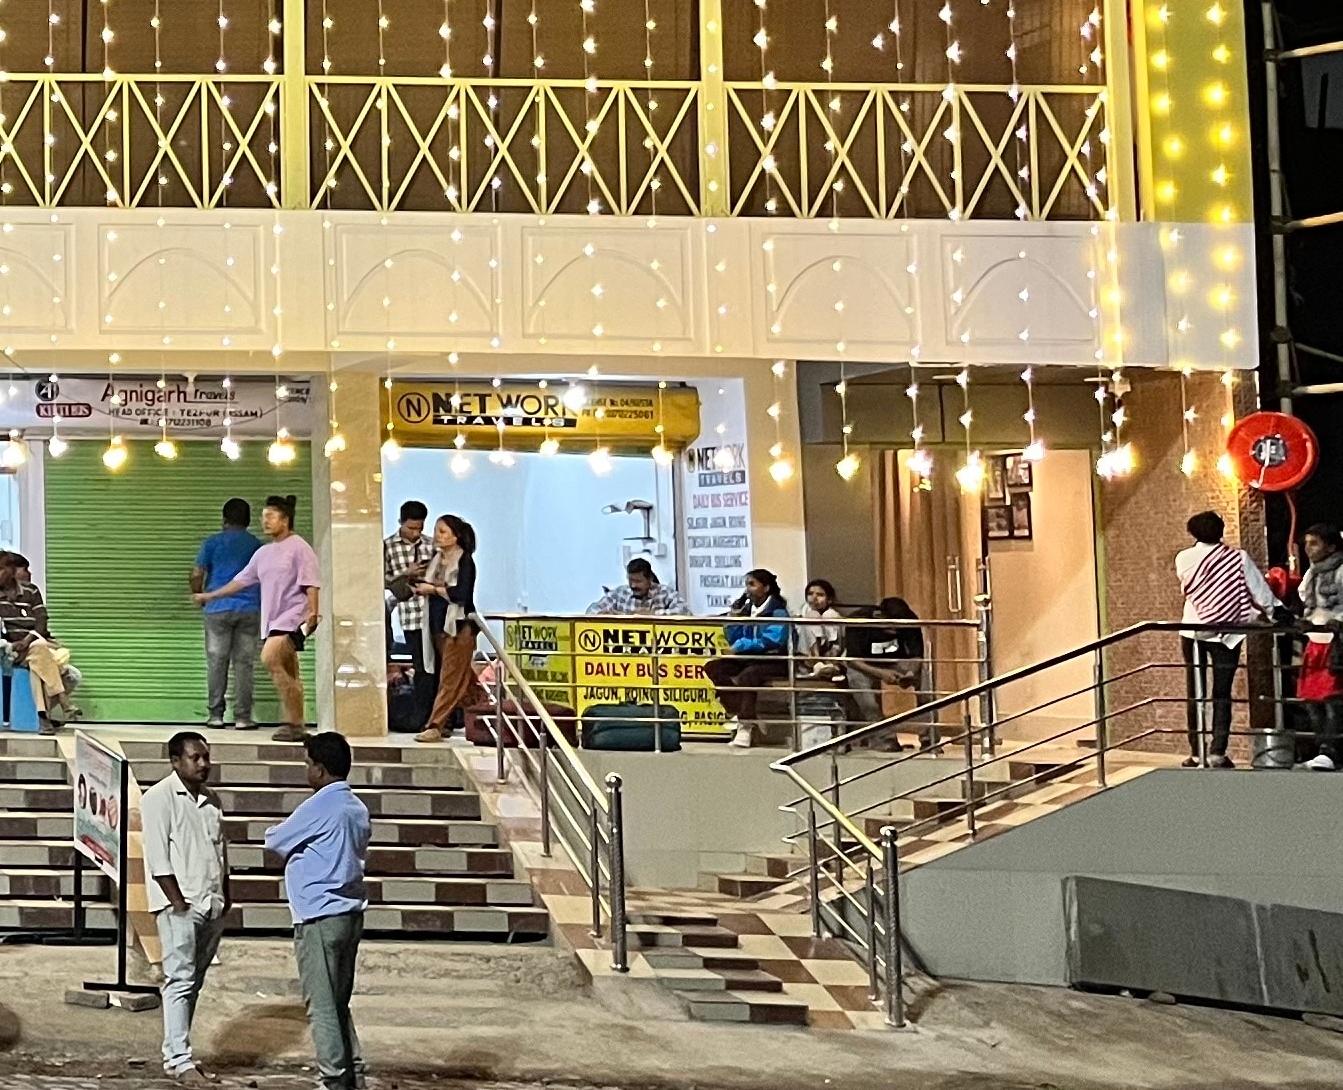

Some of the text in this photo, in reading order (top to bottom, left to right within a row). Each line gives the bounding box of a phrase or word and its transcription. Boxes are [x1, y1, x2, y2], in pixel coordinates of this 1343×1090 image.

[101, 382, 236, 406] Agnigarh Travels
[603, 629, 716, 647] NETWORK
[585, 662, 629, 677] DAILY
[636, 663, 668, 678] BUS
